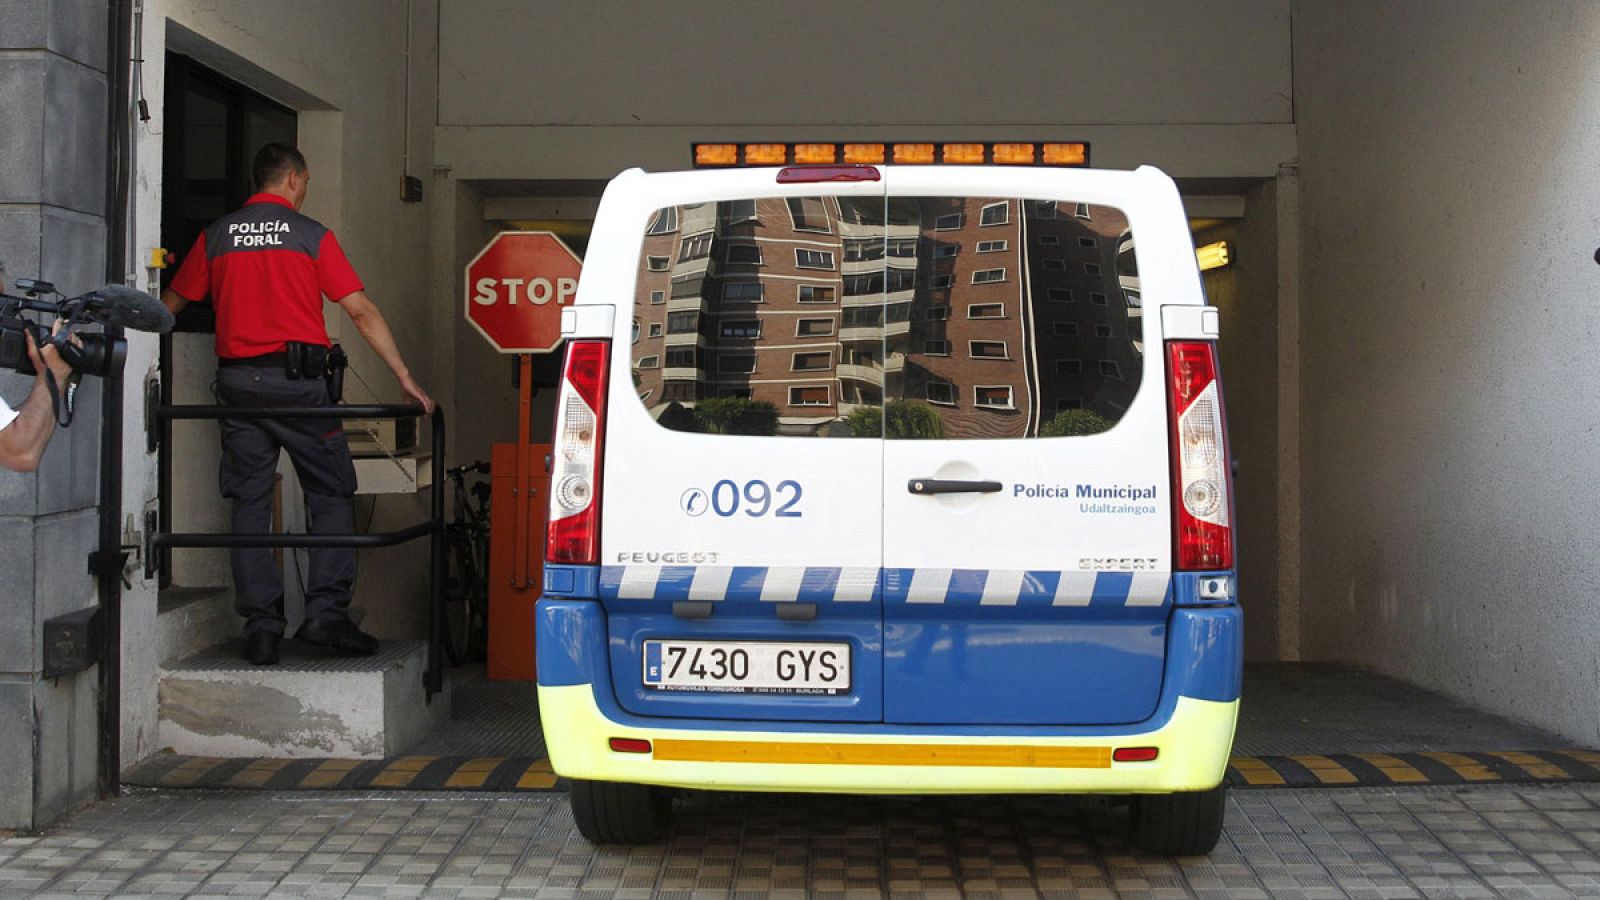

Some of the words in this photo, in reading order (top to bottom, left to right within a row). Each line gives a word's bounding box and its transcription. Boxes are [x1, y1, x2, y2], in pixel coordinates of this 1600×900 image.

[228, 219, 290, 234] POLICÍA
[233, 234, 283, 247] FORAL
[473, 276, 577, 306] STOP
[711, 479, 804, 517] 092
[1013, 483, 1069, 498] Policía
[1075, 484, 1157, 500] Municipal
[1079, 503, 1156, 515] Udaltzaingoa
[616, 552, 720, 564] PEUGEOT
[1079, 557, 1158, 570] EXPERT
[650, 666, 658, 676] E
[668, 647, 749, 681] 7430
[776, 649, 838, 682] GYS
